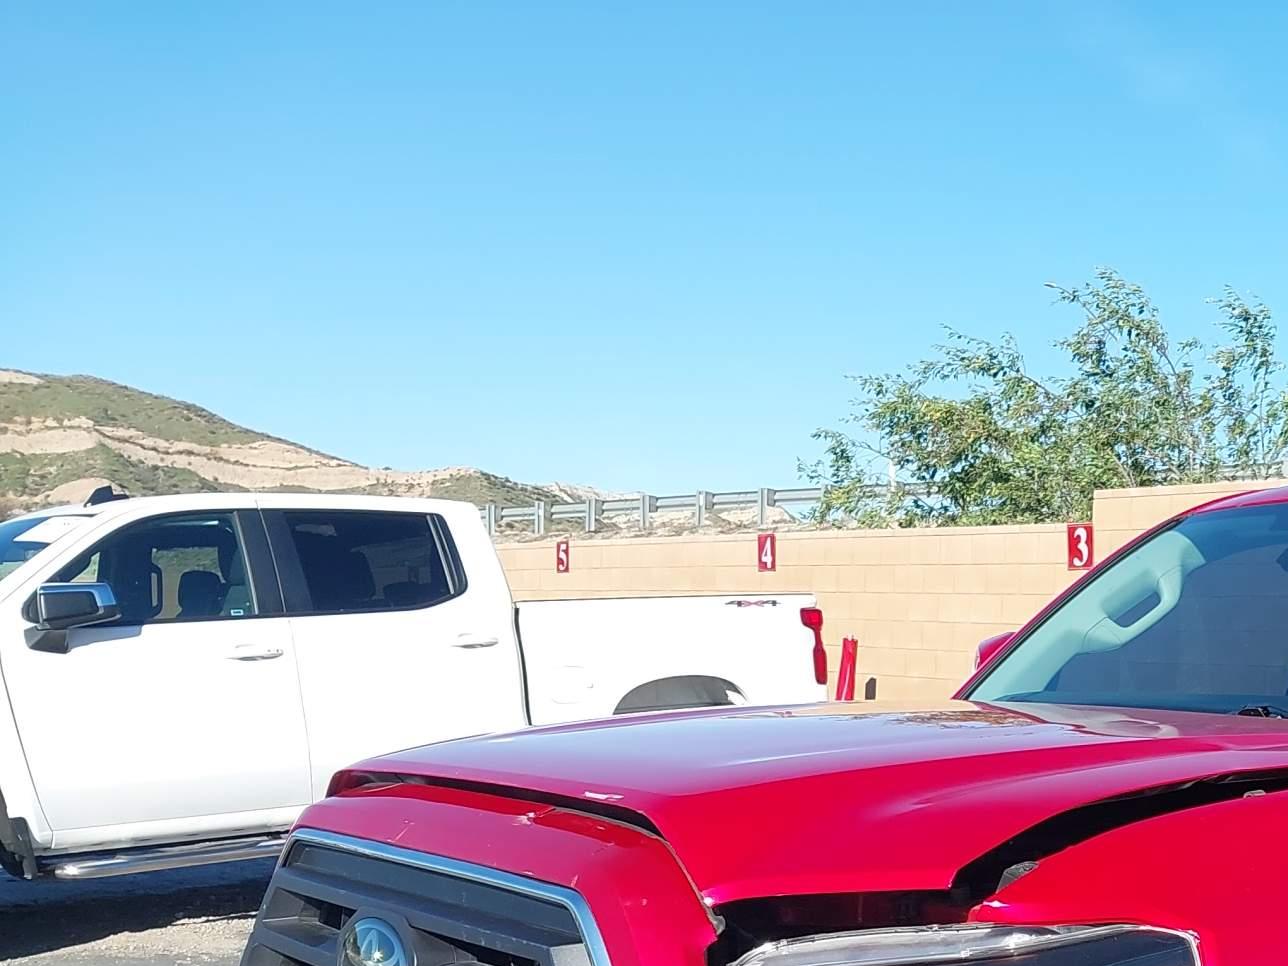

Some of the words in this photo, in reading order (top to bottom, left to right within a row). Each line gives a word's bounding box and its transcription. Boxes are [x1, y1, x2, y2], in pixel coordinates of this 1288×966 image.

[558, 543, 568, 571] 5
[761, 536, 773, 569] 4
[1072, 527, 1089, 567] 3
